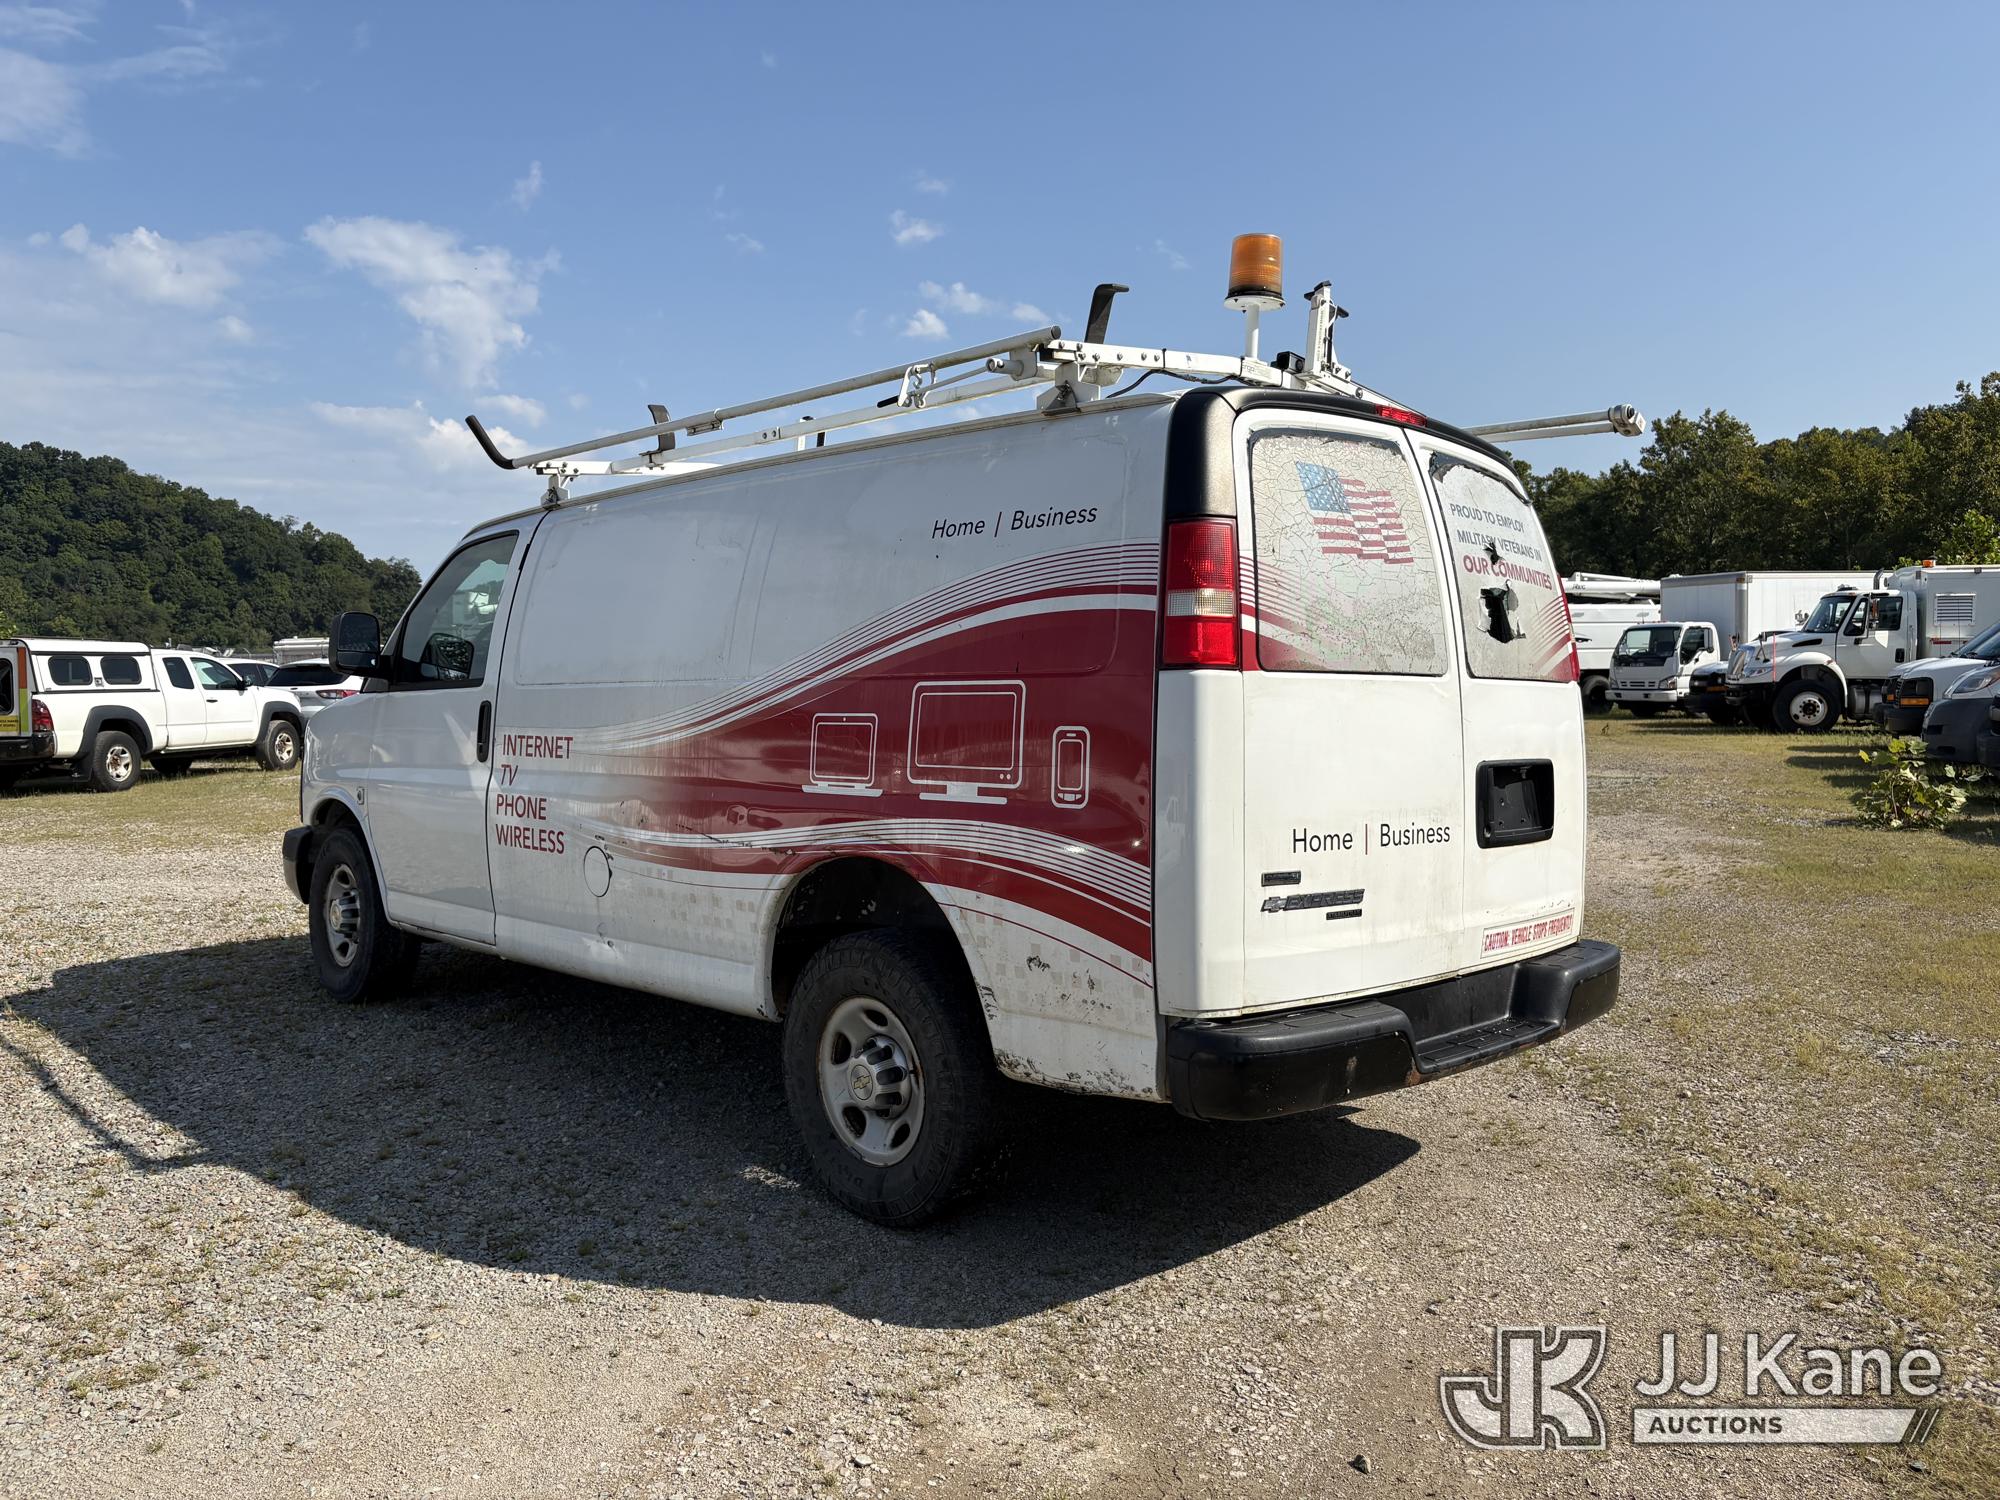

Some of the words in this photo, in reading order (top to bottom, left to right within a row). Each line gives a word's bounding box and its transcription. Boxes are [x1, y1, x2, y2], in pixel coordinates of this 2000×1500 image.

[931, 519, 986, 539] Home
[1010, 506, 1098, 530] Business
[1449, 503, 1483, 521] PROUD
[1483, 510, 1496, 525] TO
[1496, 514, 1525, 533] EMPLOY
[1497, 537, 1535, 559] VETERANS
[1534, 549, 1543, 562] IN
[1463, 554, 1490, 576] OUR
[1491, 561, 1553, 590] COMMUNITIES
[502, 734, 573, 759] INTERNET
[500, 764, 519, 786] TV
[496, 793, 547, 820] PHONE
[495, 823, 565, 854] WIRELESS
[1293, 828, 1353, 853] Home
[1380, 822, 1450, 847] Business
[1511, 925, 1533, 945] VEHICLE
[1532, 921, 1548, 940] STOPS
